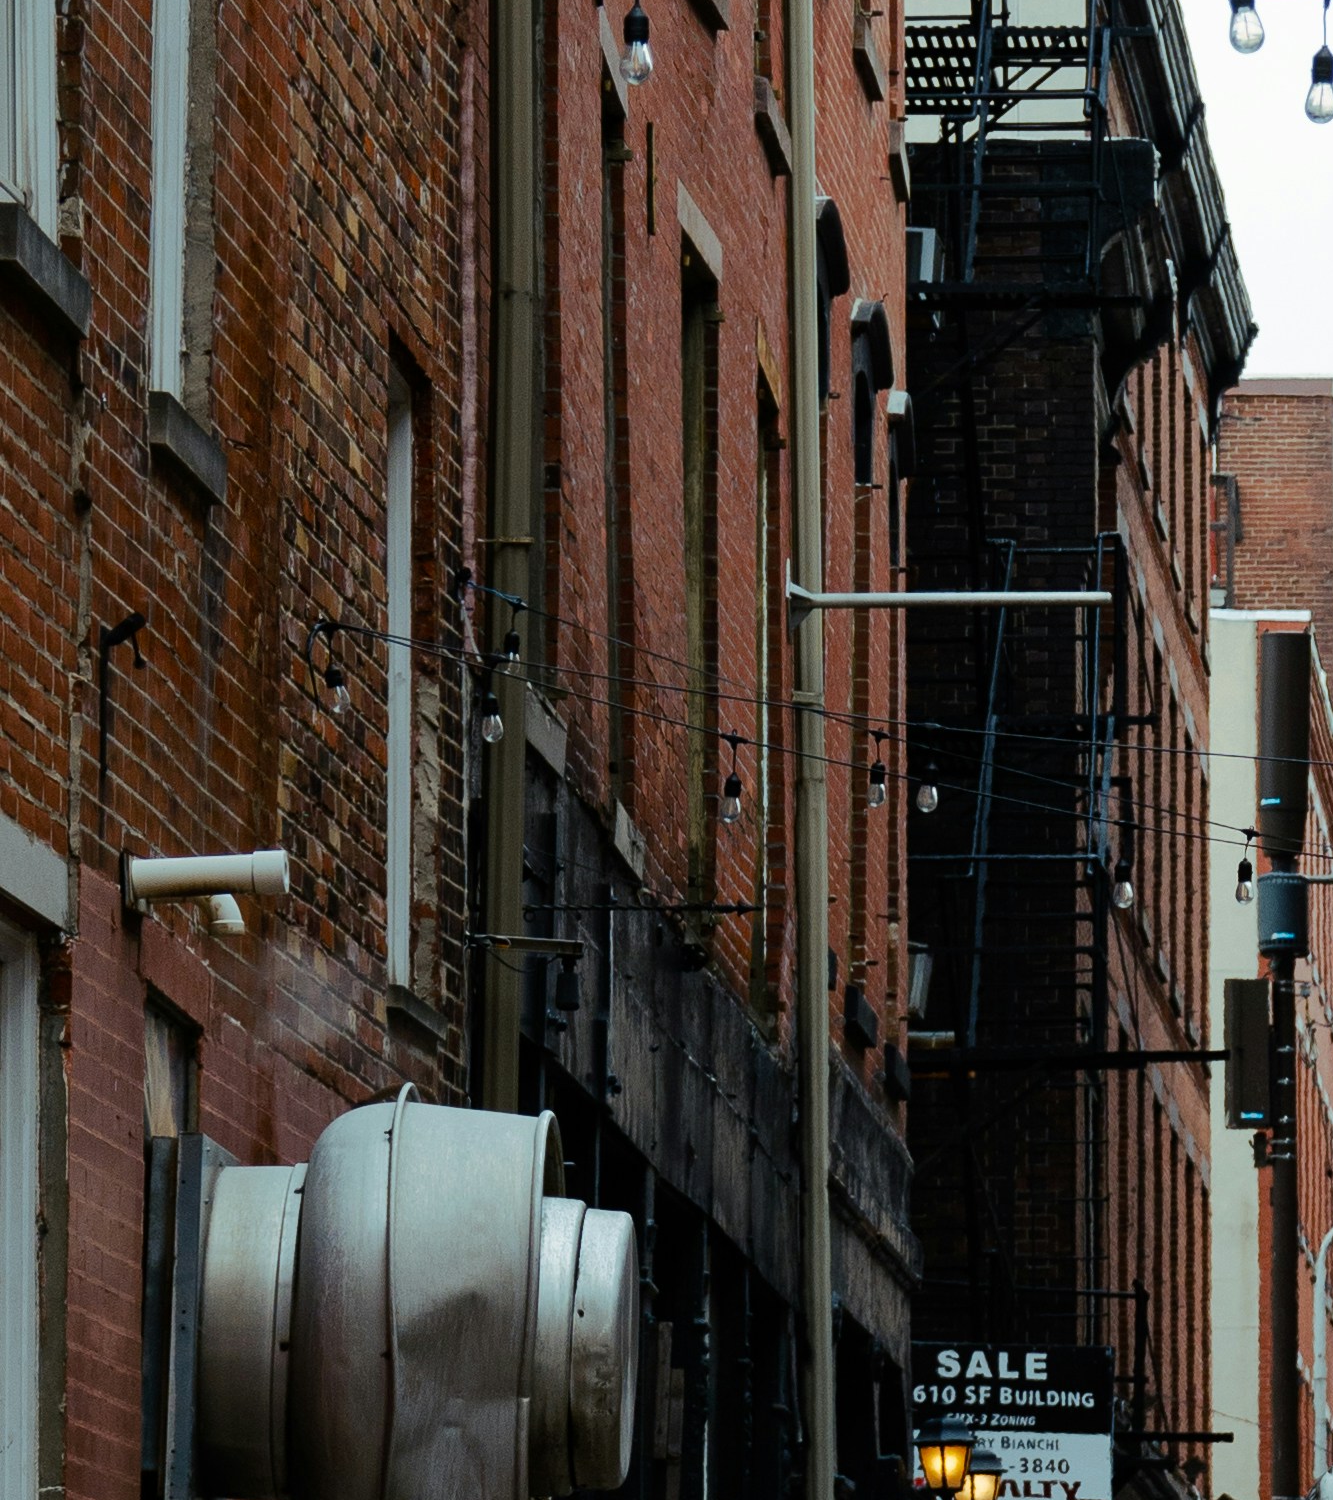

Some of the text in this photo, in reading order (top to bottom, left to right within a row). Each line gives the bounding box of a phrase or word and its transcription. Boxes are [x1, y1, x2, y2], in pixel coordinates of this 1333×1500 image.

[936, 1349, 1048, 1381] SALE
[964, 1385, 992, 1405] SF
[999, 1388, 1095, 1408] BUILDING
[990, 1413, 1037, 1427] ZONING
[1001, 1435, 1061, 1451] BIANCHI
[1008, 1457, 1071, 1475] -3840
